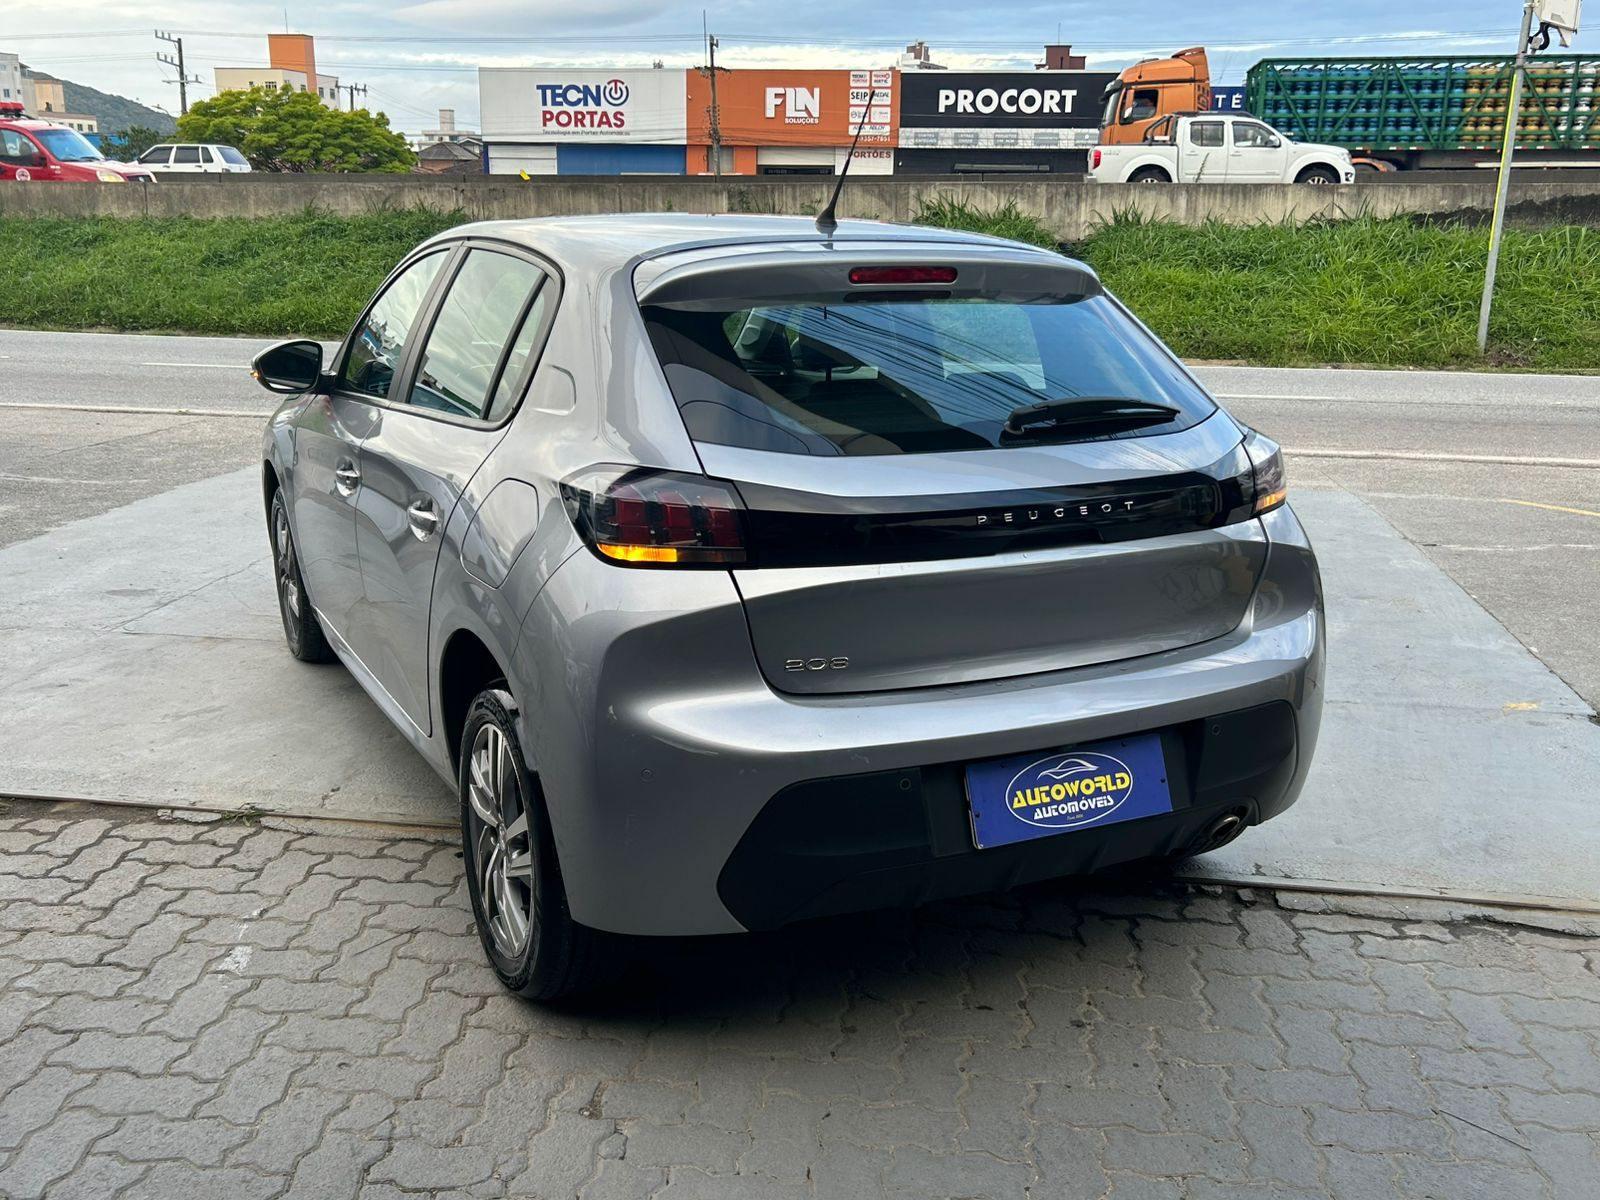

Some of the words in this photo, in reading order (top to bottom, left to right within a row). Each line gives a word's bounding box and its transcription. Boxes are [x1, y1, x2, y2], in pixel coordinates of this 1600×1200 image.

[850, 91, 869, 100] SEIP
[938, 88, 1078, 114] PROCORT
[542, 110, 625, 127] PORTAS
[977, 501, 1134, 525] PEUGEOT
[785, 656, 849, 672] 208
[1012, 771, 1131, 809] AUTOWORLD
[1033, 795, 1115, 820] AUTOMÓVEIS
